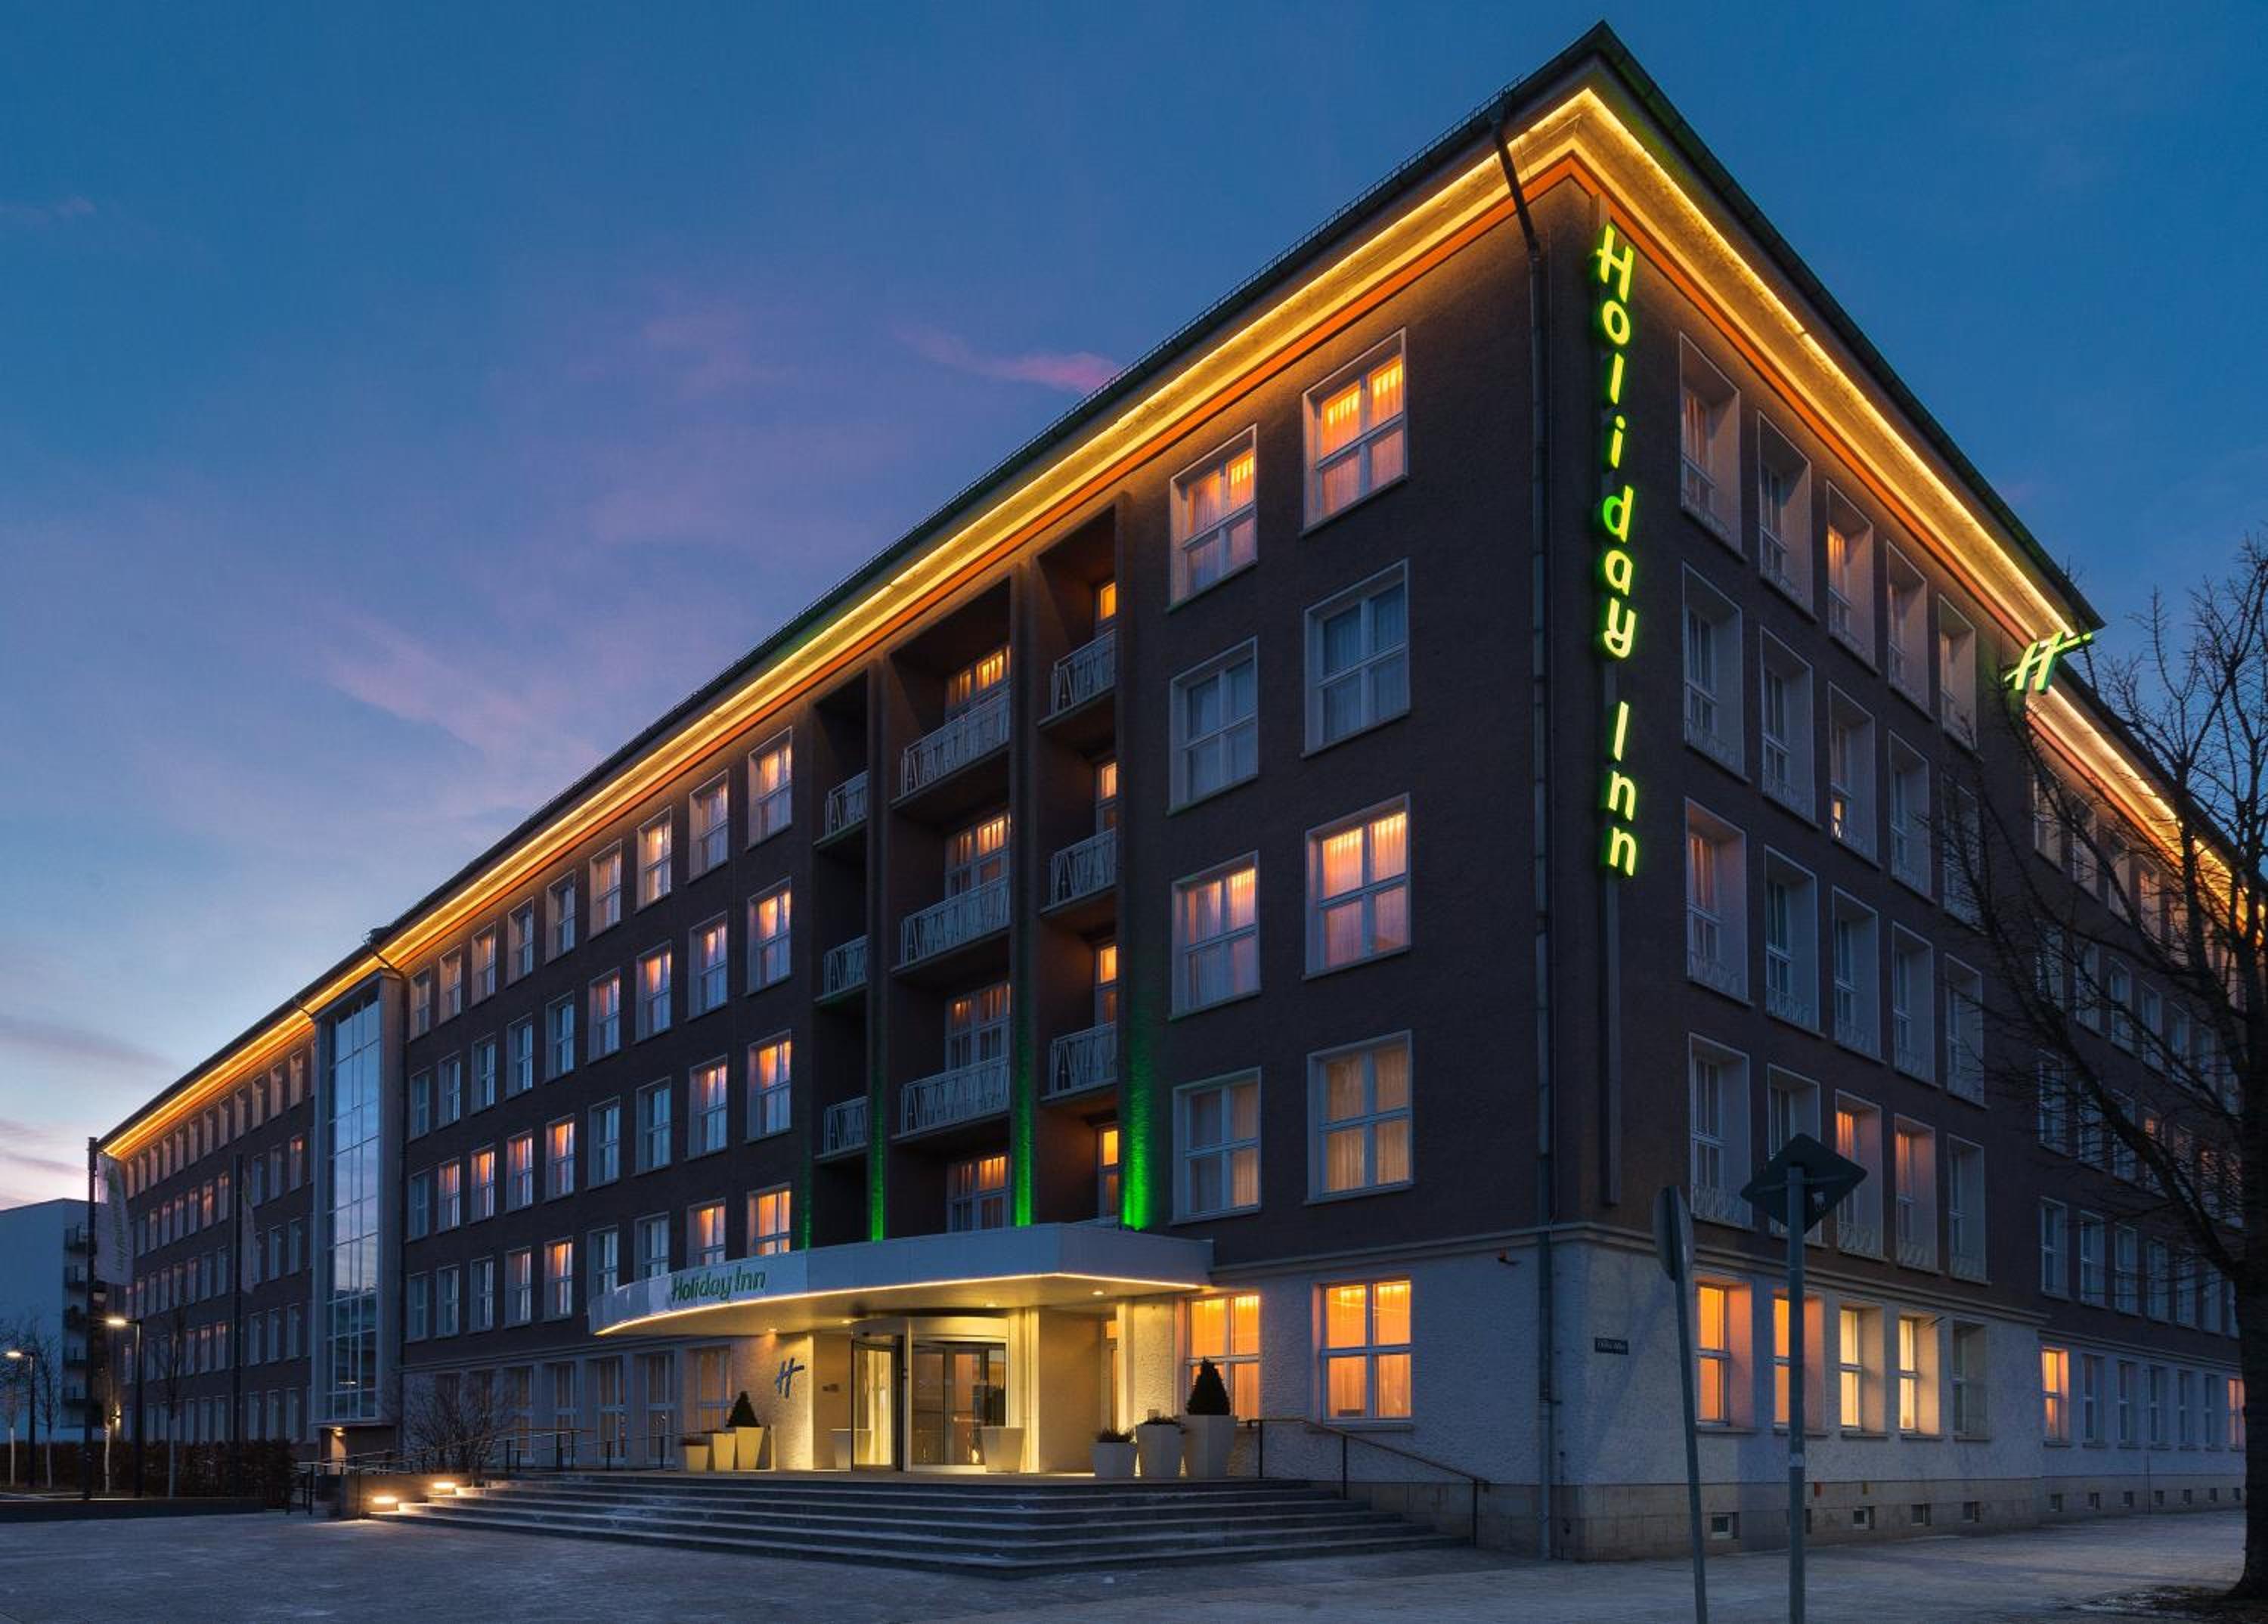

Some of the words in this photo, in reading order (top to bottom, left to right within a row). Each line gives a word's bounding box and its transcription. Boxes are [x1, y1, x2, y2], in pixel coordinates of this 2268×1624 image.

[1596, 224, 1635, 659] Holiday
[1608, 700, 1636, 876] Inn
[671, 1271, 732, 1301] Holiday
[734, 1264, 767, 1291] Inn
